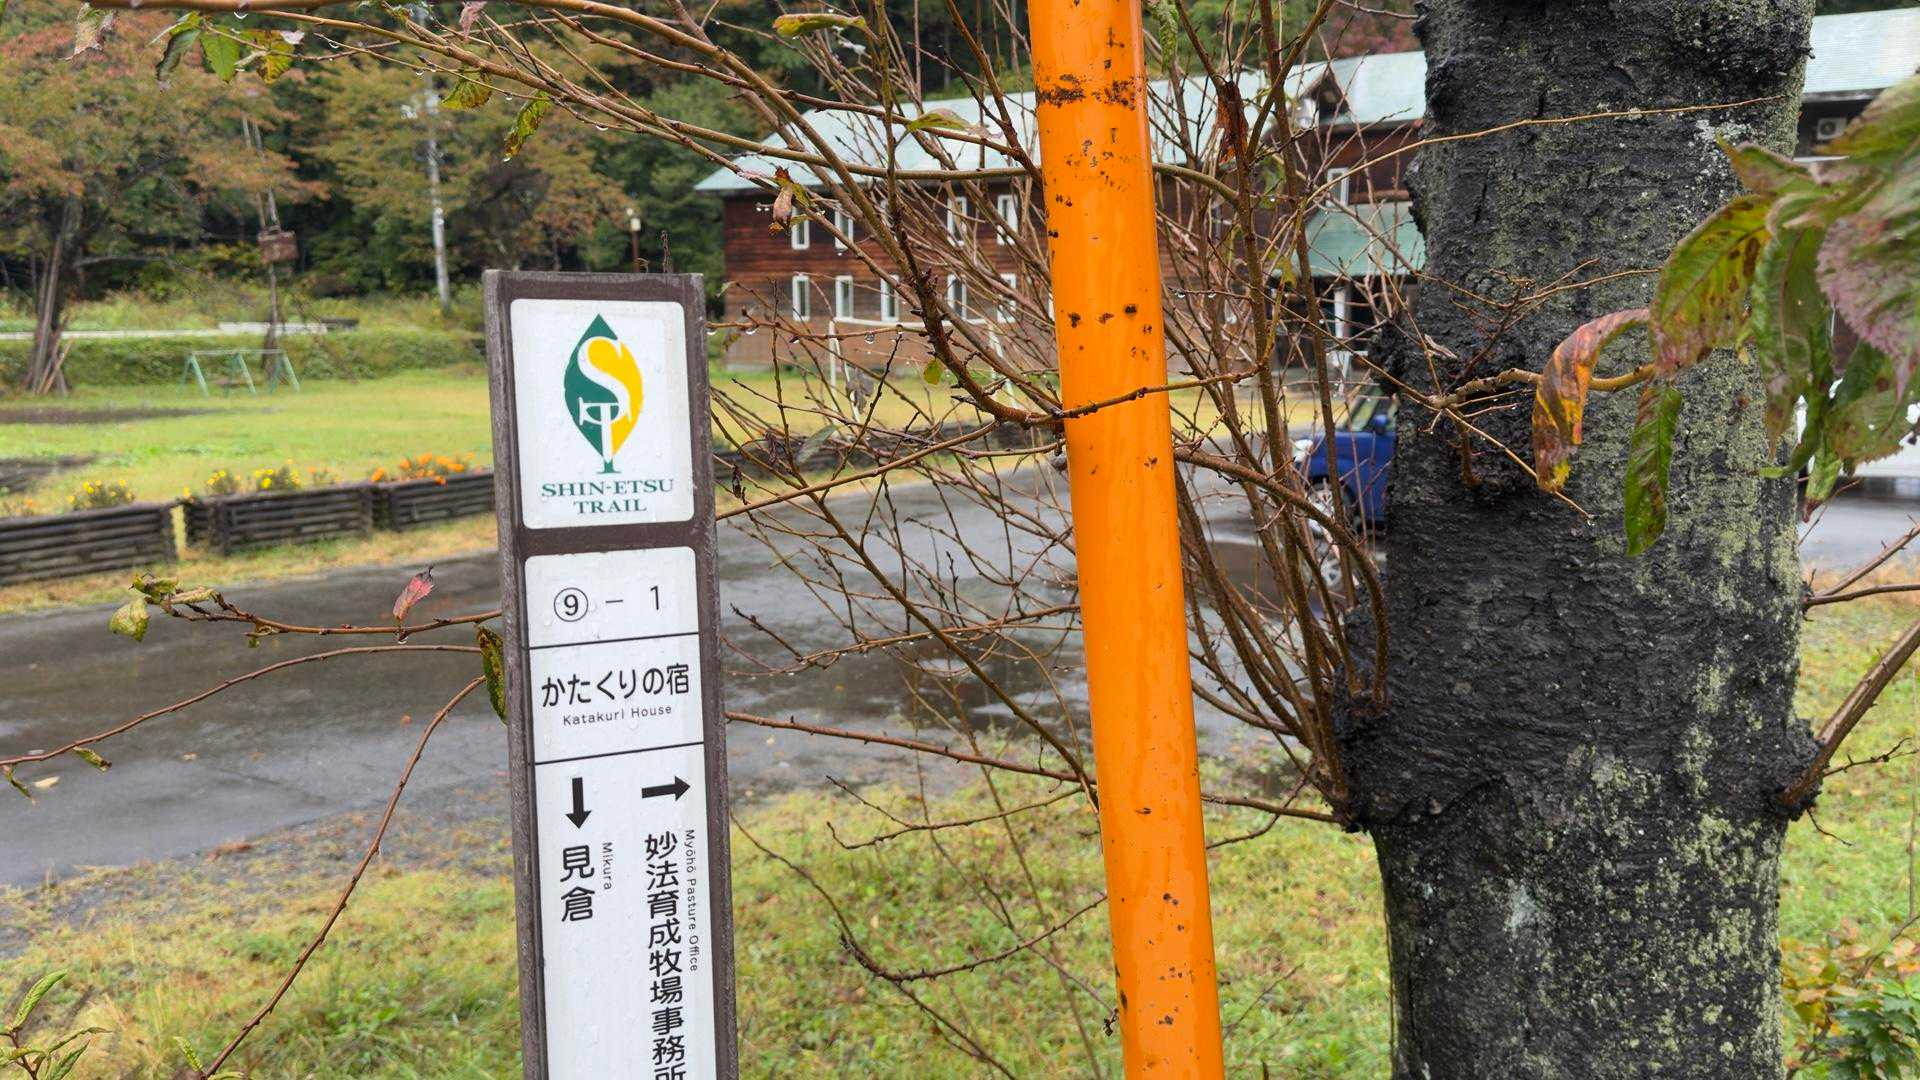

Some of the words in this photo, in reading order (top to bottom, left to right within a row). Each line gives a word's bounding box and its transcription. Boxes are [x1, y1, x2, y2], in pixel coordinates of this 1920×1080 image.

[541, 479, 674, 497] SHIN-ETSU
[573, 499, 647, 514] TRAIL
[541, 662, 689, 707] かたくりの宿
[563, 709, 625, 726] Katakuri
[631, 704, 672, 718] House
[560, 844, 595, 922] 見倉
[602, 841, 616, 890] Mikura
[687, 878, 697, 930] Pasture
[689, 934, 699, 972] Office
